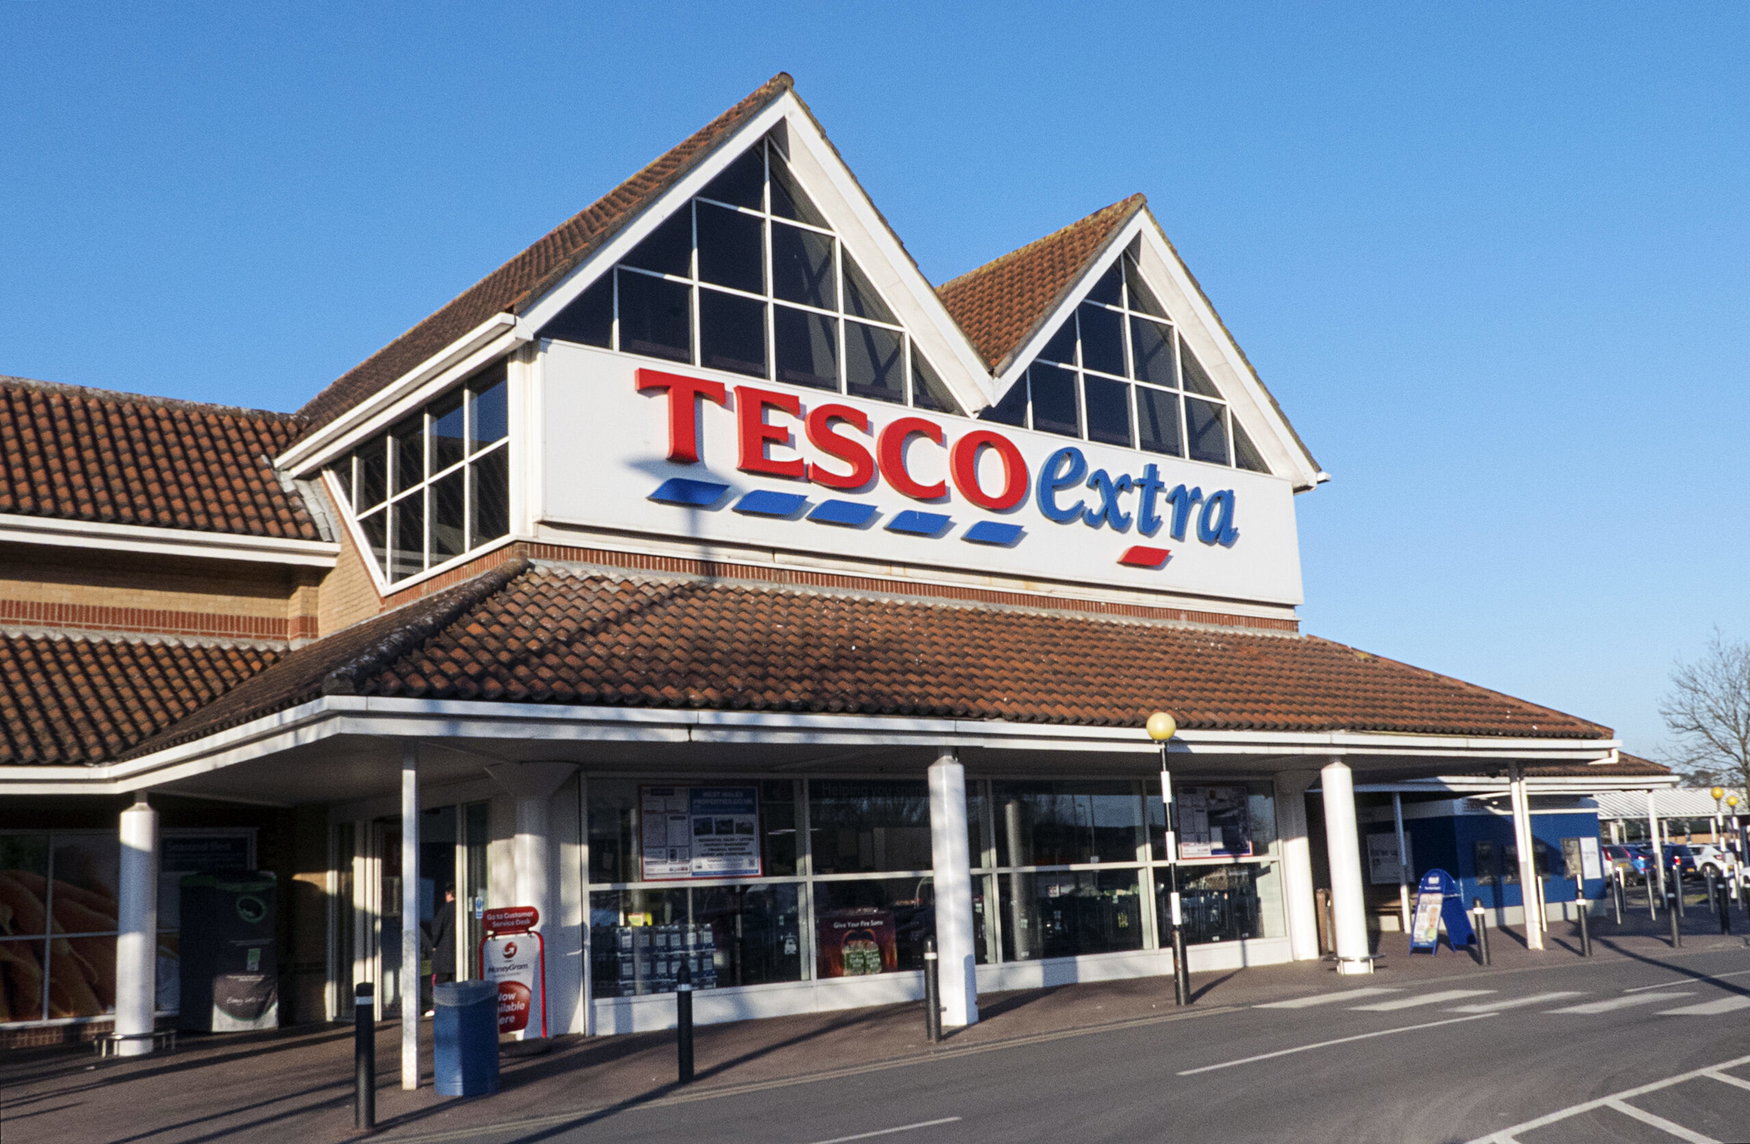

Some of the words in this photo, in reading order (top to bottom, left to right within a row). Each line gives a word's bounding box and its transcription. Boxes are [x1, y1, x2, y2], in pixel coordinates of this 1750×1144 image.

[634, 368, 1029, 510] TESCO
[1036, 446, 1239, 548] extra
[503, 911, 534, 919] Customer
[492, 920, 514, 928] Service
[515, 918, 531, 926] Desk
[833, 920, 846, 929] Give
[488, 963, 528, 974] MoneyGram
